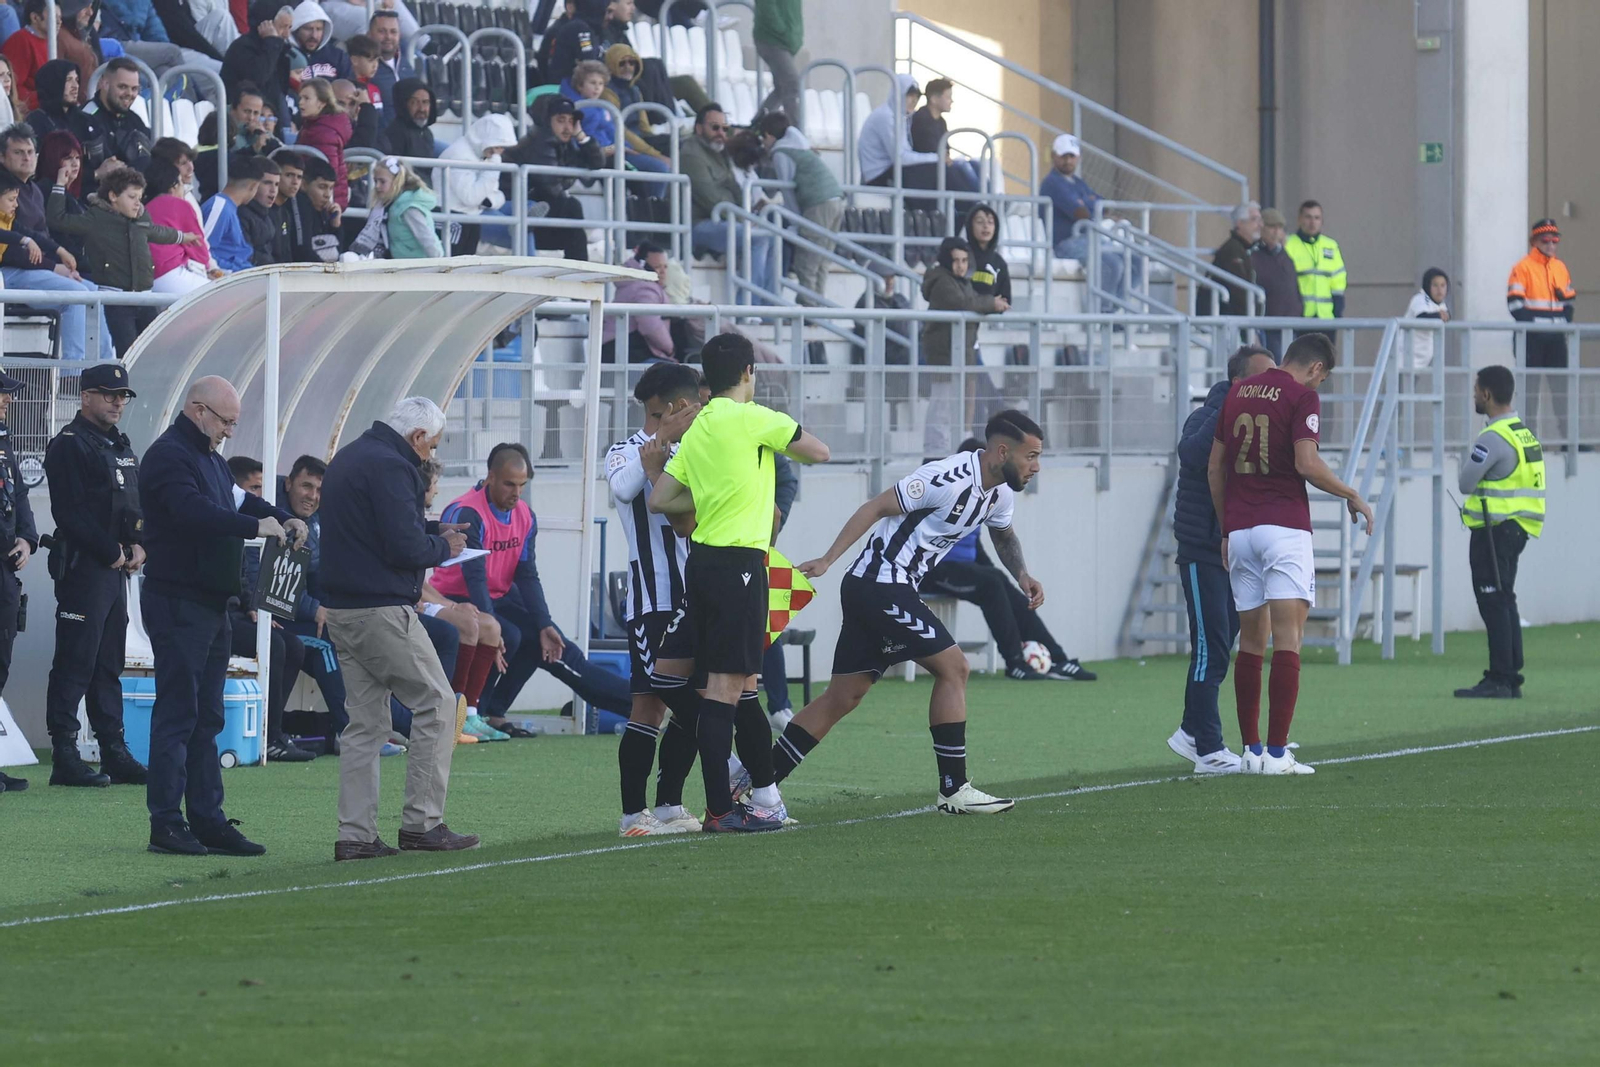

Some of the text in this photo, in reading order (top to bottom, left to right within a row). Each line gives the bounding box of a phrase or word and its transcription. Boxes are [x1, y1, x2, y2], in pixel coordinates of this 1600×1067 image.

[1236, 384, 1282, 402] MORILLAS
[1233, 412, 1270, 475] 21
[491, 536, 520, 552] oma
[270, 555, 302, 603] 1912
